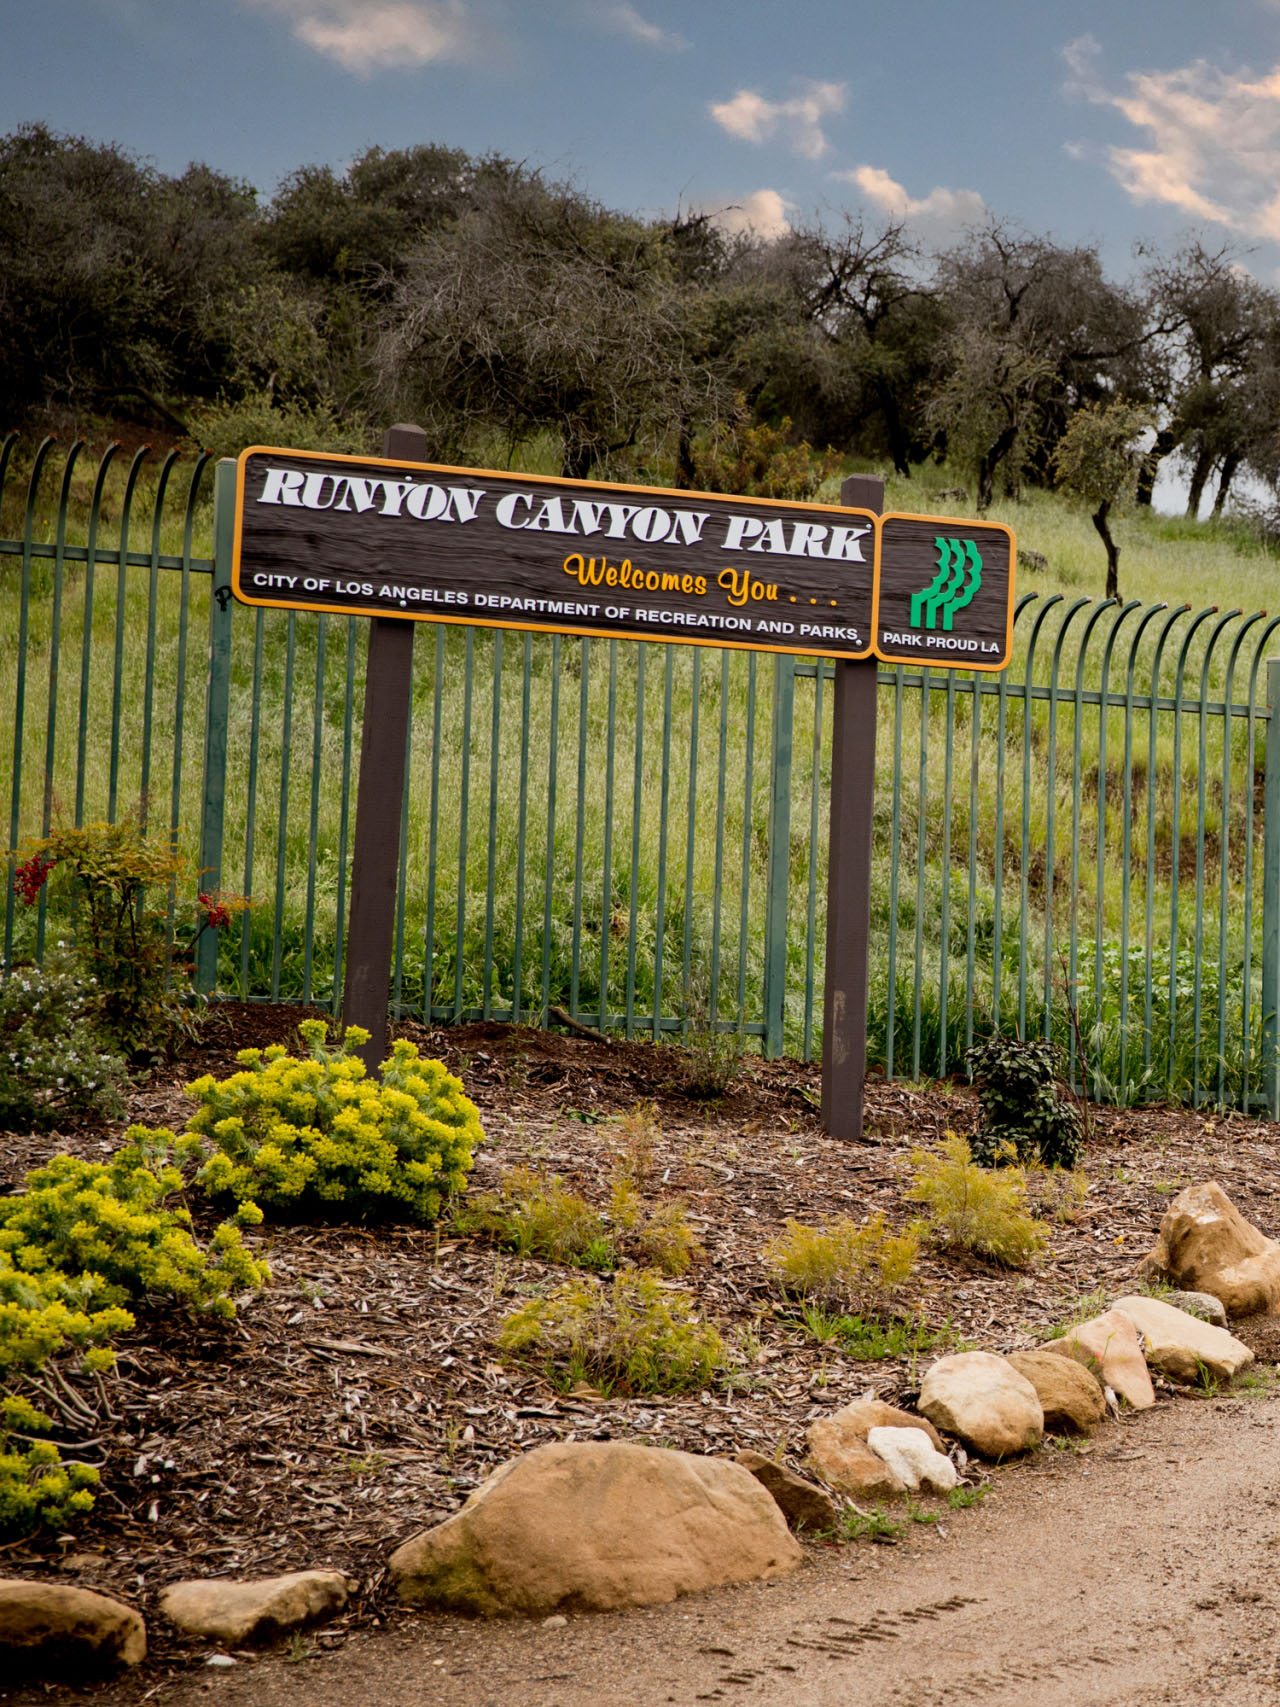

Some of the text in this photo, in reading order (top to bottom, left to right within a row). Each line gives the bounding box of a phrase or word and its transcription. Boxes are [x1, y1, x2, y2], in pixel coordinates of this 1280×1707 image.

[257, 468, 872, 562] RUNYON CANYON PARK
[253, 573, 858, 640] CITY OF LOS ANGELES DEPARTMENT OF RECREATION AND PARKS
[563, 553, 707, 595] Welcomes
[717, 567, 778, 607] You
[883, 631, 1000, 653] PARK PROUD LA
